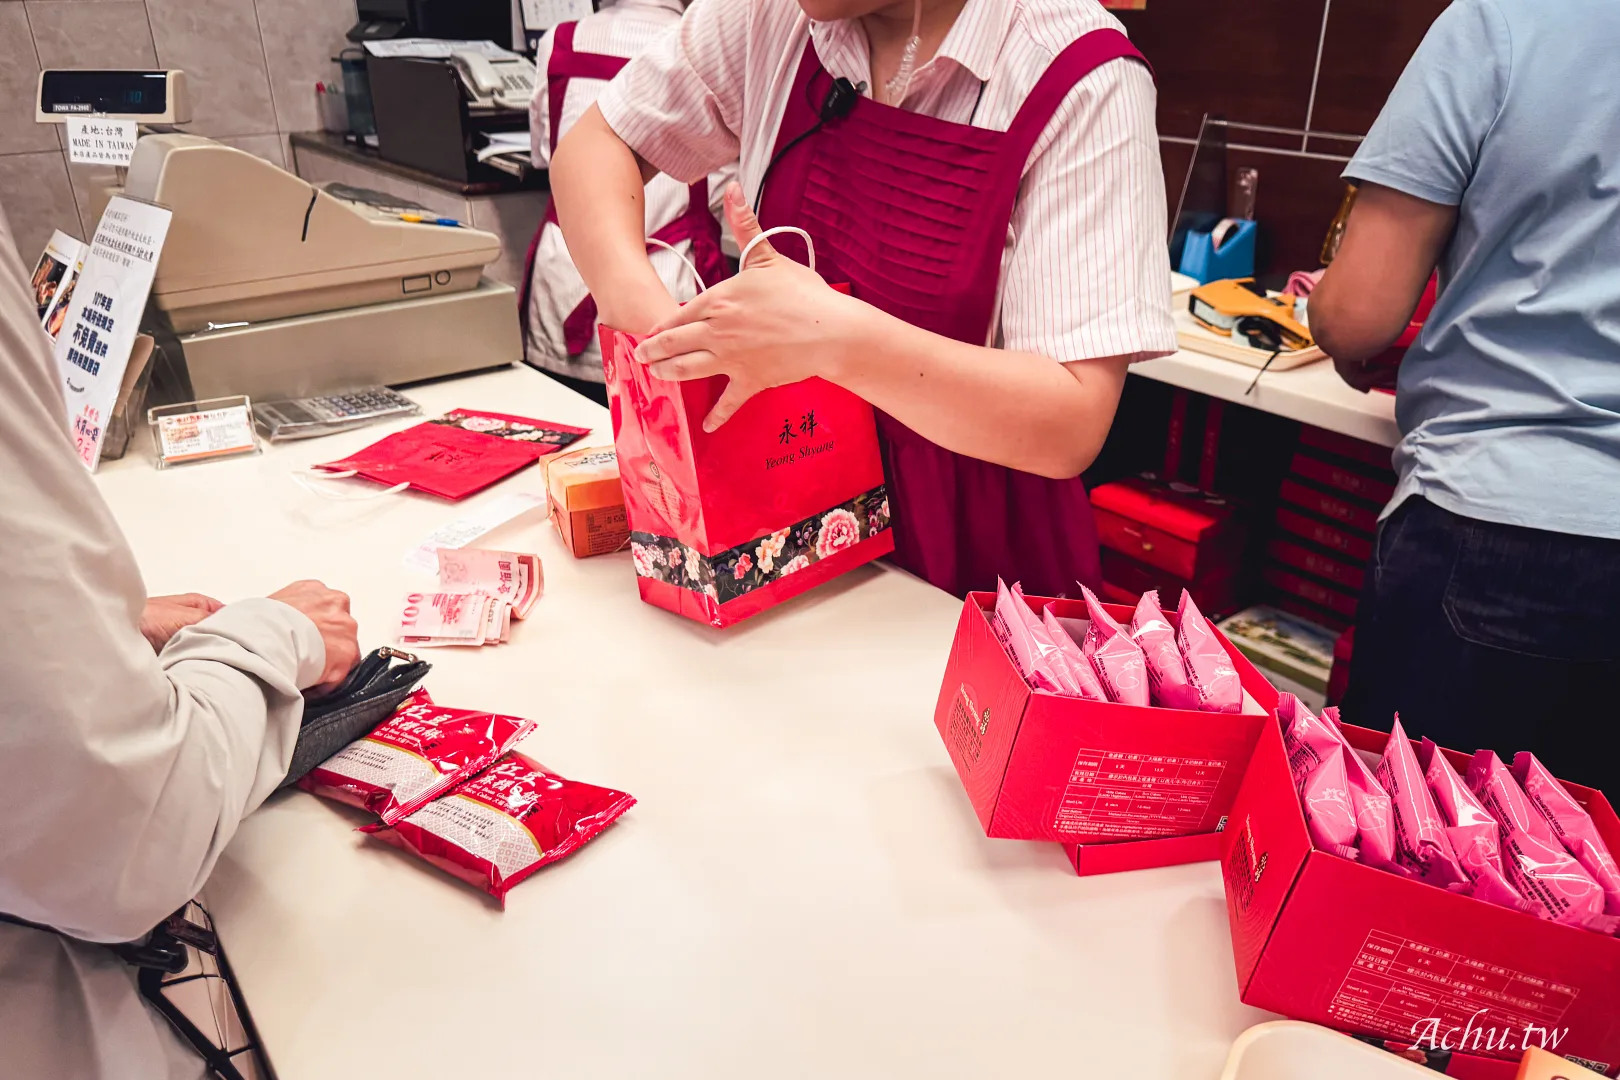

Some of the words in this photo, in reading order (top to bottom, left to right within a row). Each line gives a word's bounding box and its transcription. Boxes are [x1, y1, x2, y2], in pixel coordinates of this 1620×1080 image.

[81, 124, 124, 137] 產地:台灣
[72, 138, 91, 148] MADE
[95, 139, 104, 149] IN
[107, 141, 135, 152] TAIWAN
[779, 409, 819, 445] 永祥
[765, 453, 795, 470] Yeong
[798, 441, 834, 459] Shyang
[401, 593, 424, 628] 100
[400, 703, 452, 727] 紅豆
[491, 762, 546, 787] 紅豆
[1360, 953, 1389, 965] 有效日期
[1366, 942, 1394, 954] 保存期限
